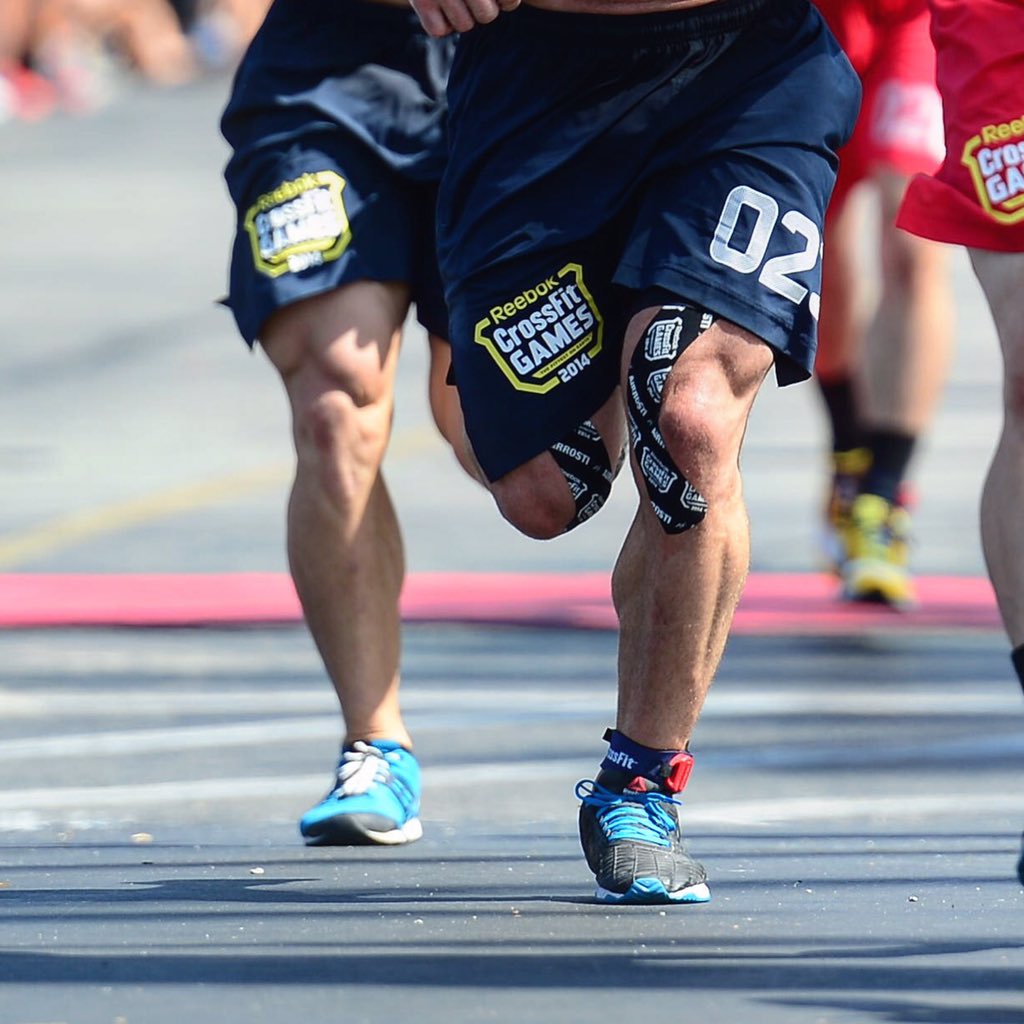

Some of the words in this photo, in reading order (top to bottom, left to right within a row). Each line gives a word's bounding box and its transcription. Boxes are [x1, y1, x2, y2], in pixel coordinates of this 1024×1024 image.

[709, 185, 823, 321] 02
[489, 275, 560, 325] Reebok
[492, 284, 582, 353] CrossFit
[509, 303, 594, 375] GAMES
[558, 352, 591, 383] 2014
